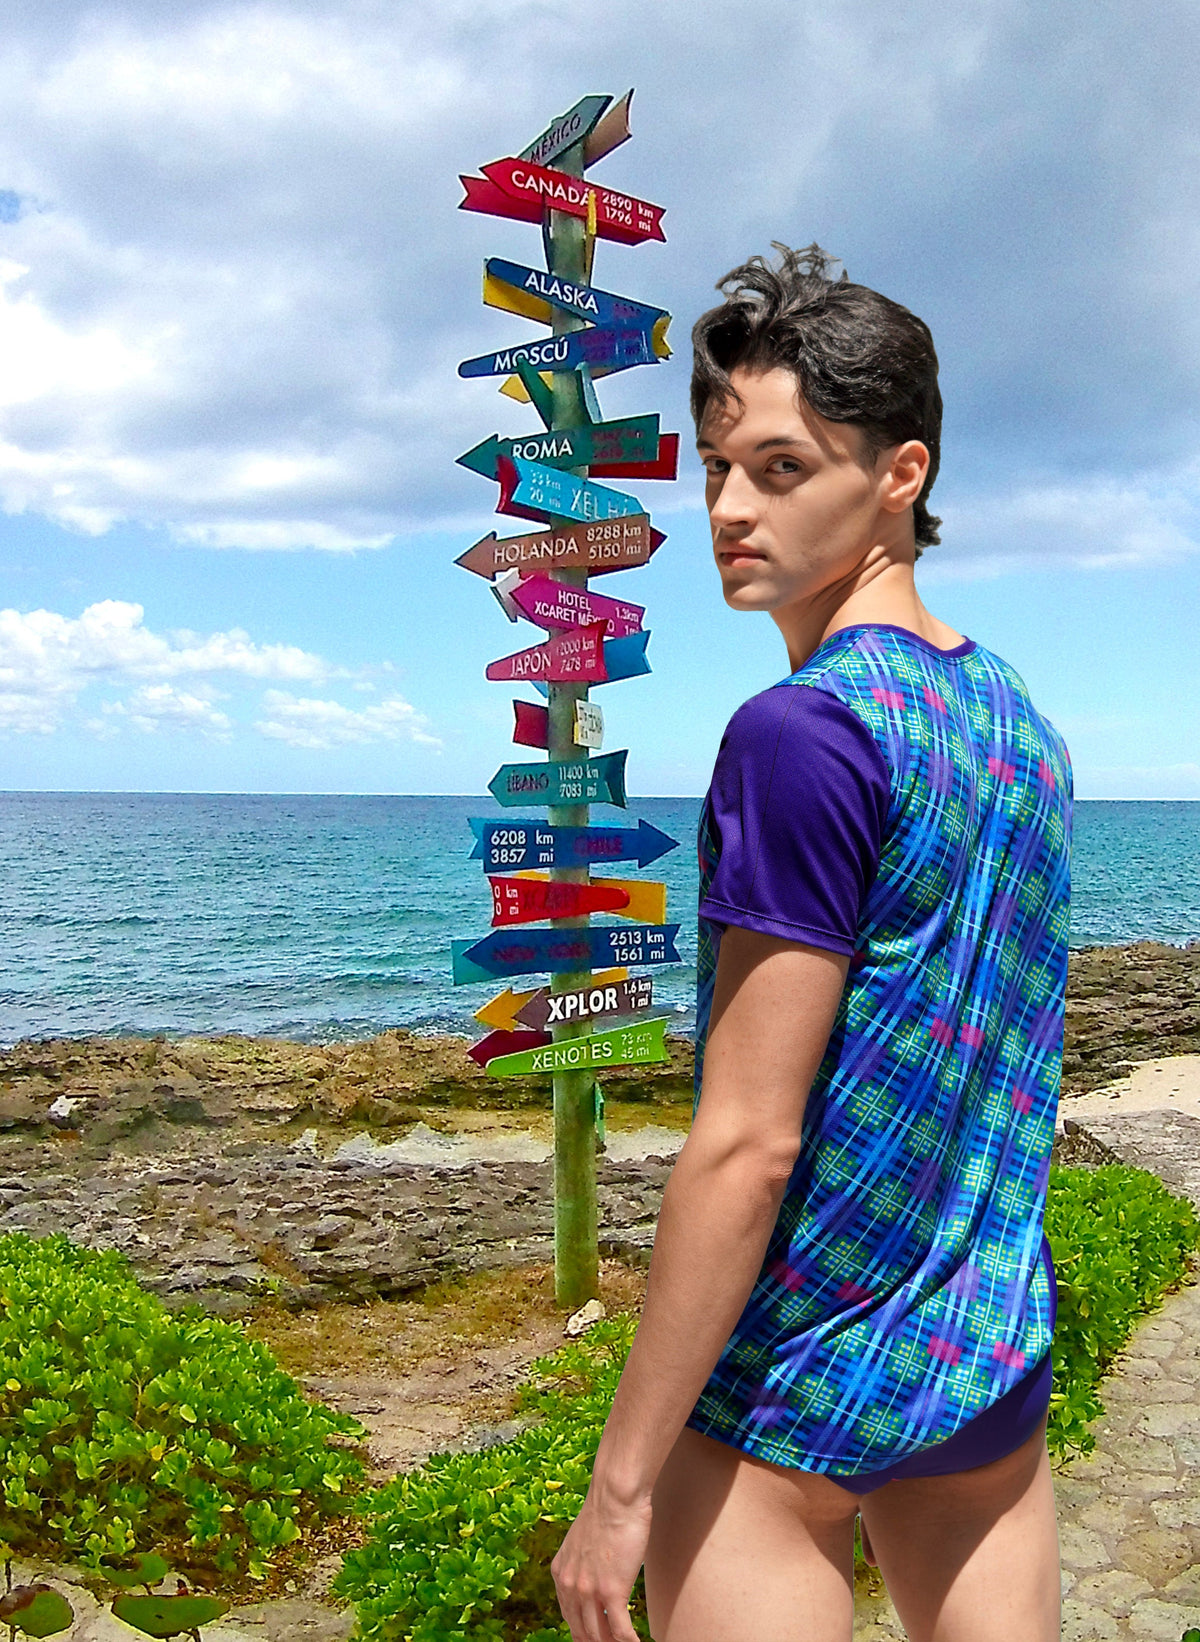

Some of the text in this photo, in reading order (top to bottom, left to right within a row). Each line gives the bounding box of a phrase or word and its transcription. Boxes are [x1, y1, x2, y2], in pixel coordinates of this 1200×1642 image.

[602, 192, 654, 219] 2890 km
[605, 206, 651, 232] 1796 mi
[525, 271, 599, 314] ALASKA
[494, 336, 568, 372] MOSCÚ
[512, 438, 573, 460] ROMA
[530, 487, 544, 503] 20
[571, 488, 602, 520] XEL
[586, 523, 641, 542] 8288 km
[494, 537, 578, 564] HOLANDA
[589, 540, 641, 559] 5150 mi
[558, 590, 591, 610] HOTEL
[534, 601, 577, 622] XCARET
[582, 636, 595, 651] km
[510, 647, 551, 677] JAPÓN
[585, 654, 596, 669] mi
[559, 764, 599, 780] 11400 km
[559, 782, 597, 798] 7083 mi
[490, 829, 554, 845] 6208 km
[490, 848, 554, 864] 3857 mi
[494, 884, 518, 899] 0 km
[496, 902, 519, 915] 0 mi
[609, 930, 665, 946] 2513 km
[614, 946, 665, 963] 1561 mi
[623, 979, 652, 995] 1.6 km
[547, 987, 618, 1023] XPLOR
[638, 994, 649, 1007] mi
[532, 1041, 613, 1070] XENOTES
[636, 1044, 650, 1057] mi
